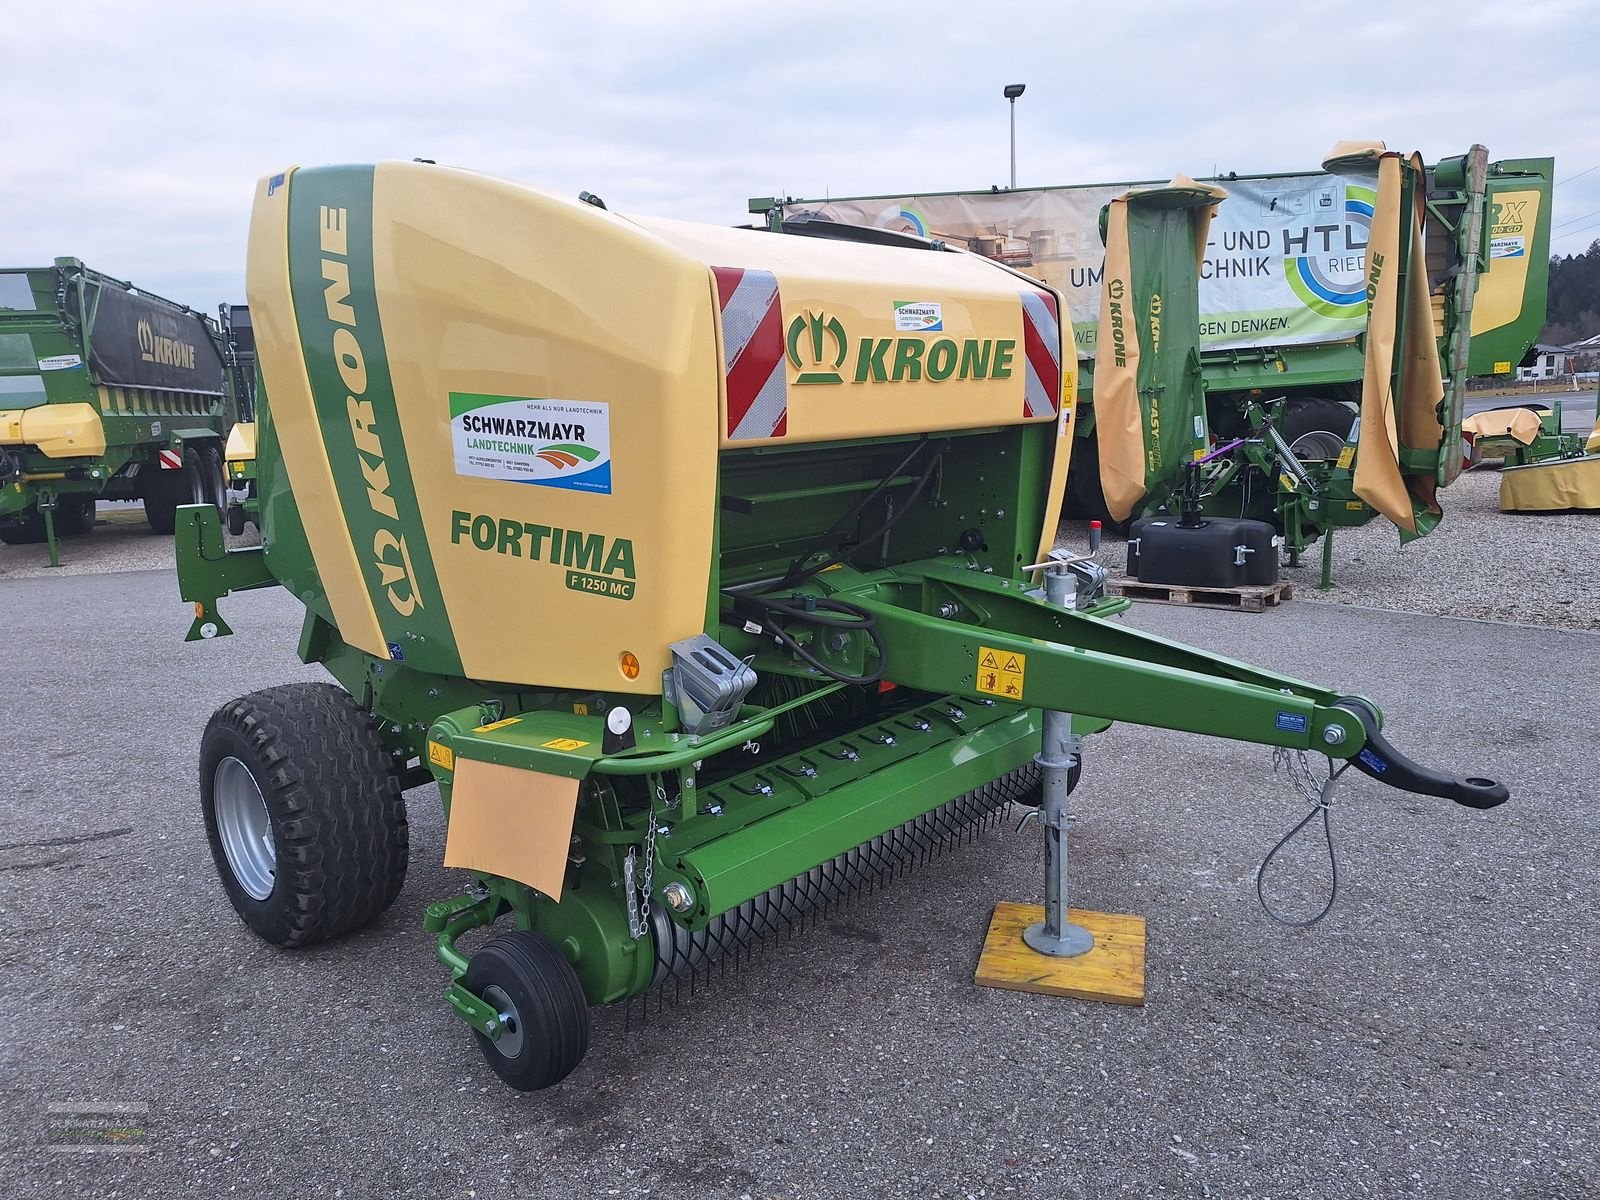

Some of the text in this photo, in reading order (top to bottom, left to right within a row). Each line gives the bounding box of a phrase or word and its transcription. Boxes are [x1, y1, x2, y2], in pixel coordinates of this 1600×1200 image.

[1223, 230, 1271, 251] UND
[1283, 225, 1368, 254] HTL
[1071, 267, 1104, 287] UM
[1200, 256, 1271, 279] CHNIK
[898, 308, 936, 316] SCHWARZMAYR
[1110, 302, 1127, 368] KRONE
[1199, 316, 1290, 335] GEN DENKEN.
[154, 335, 195, 370] KRONE
[320, 206, 399, 520] KRONE
[851, 336, 1016, 385] KRONE
[565, 407, 604, 415] LANDTECHNIK.
[463, 414, 585, 442] SCHWARZMAYR
[1150, 398, 1162, 466] EASYCUT
[467, 438, 535, 455] LANDTECHNIK
[450, 510, 636, 580] FORTIMA
[570, 575, 630, 597] F 1250 MC
